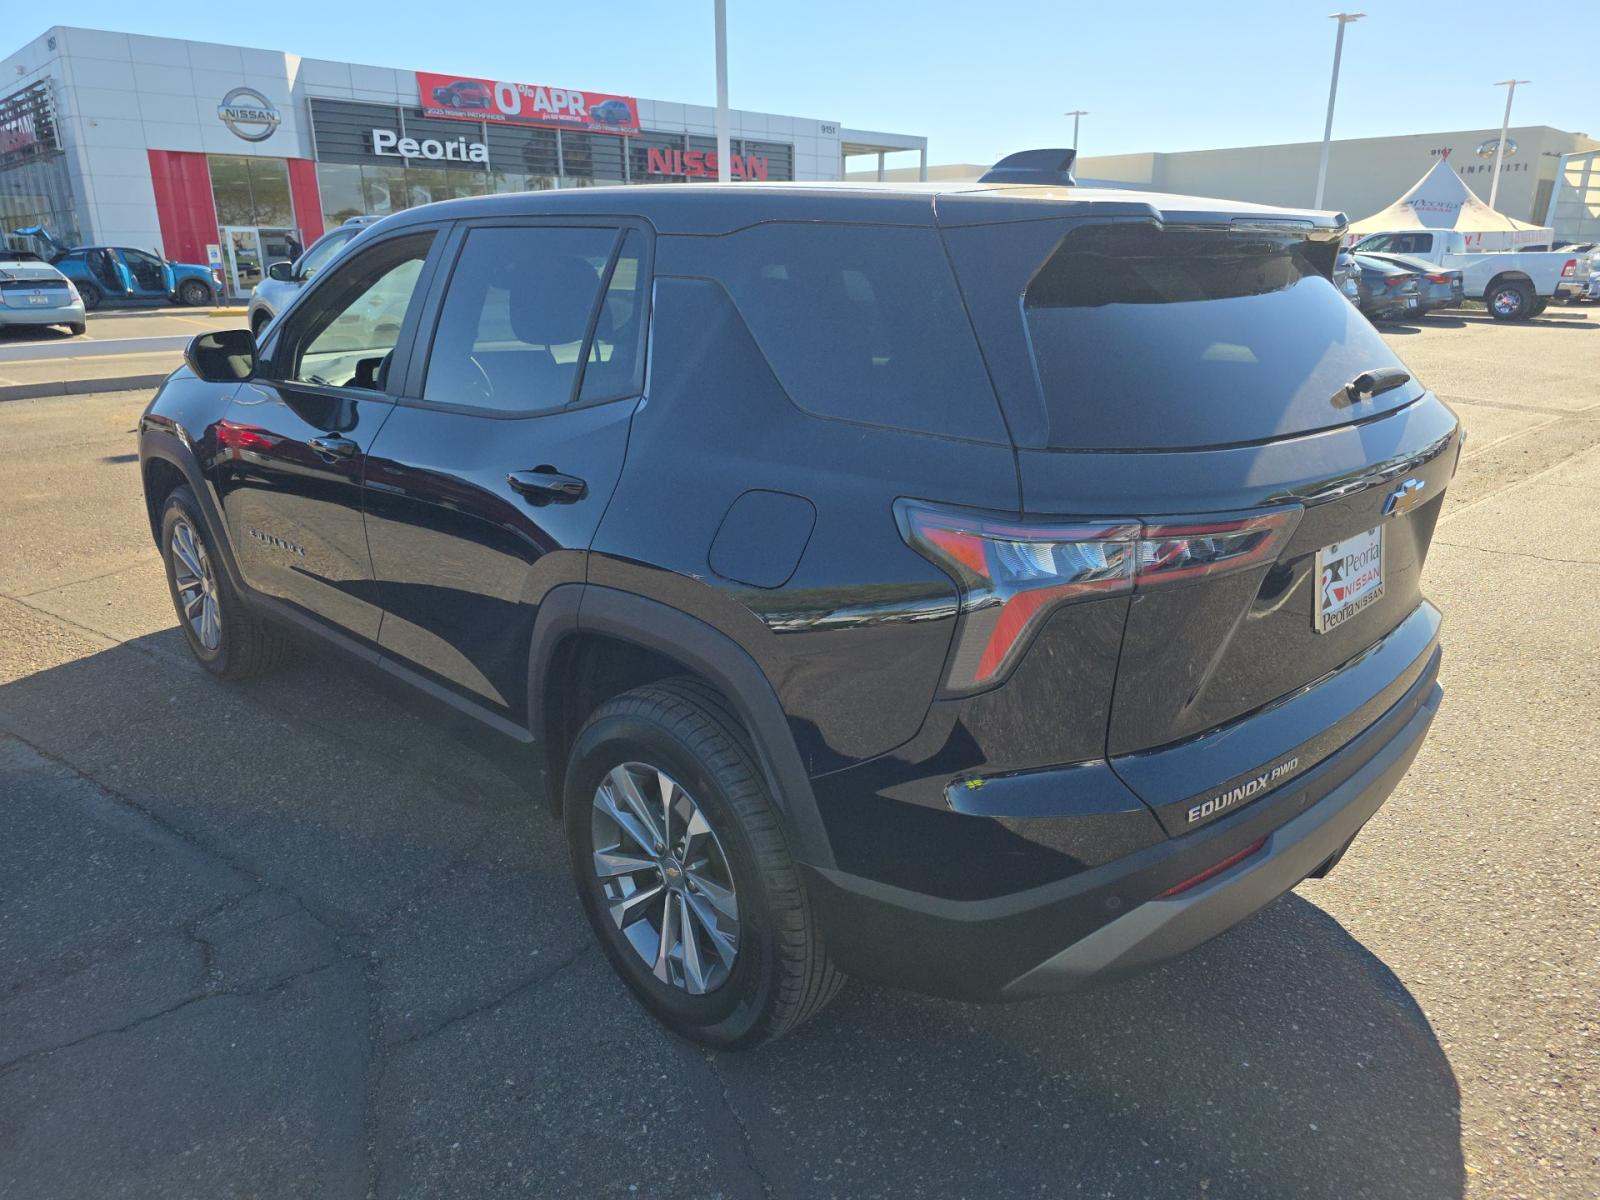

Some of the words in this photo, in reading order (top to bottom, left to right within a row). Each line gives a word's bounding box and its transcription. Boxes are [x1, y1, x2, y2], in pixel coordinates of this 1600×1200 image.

[225, 108, 275, 120] NISSAN
[533, 86, 588, 116] APR
[372, 128, 489, 163] Peoria
[647, 146, 769, 181] NISSAN
[1344, 542, 1380, 577] Peoria
[1344, 566, 1380, 598] NISSAN
[1322, 601, 1354, 631] Peoria
[1354, 585, 1384, 611] NISSAN
[1188, 773, 1269, 823] EQUINOX
[1271, 757, 1298, 780] AWD
